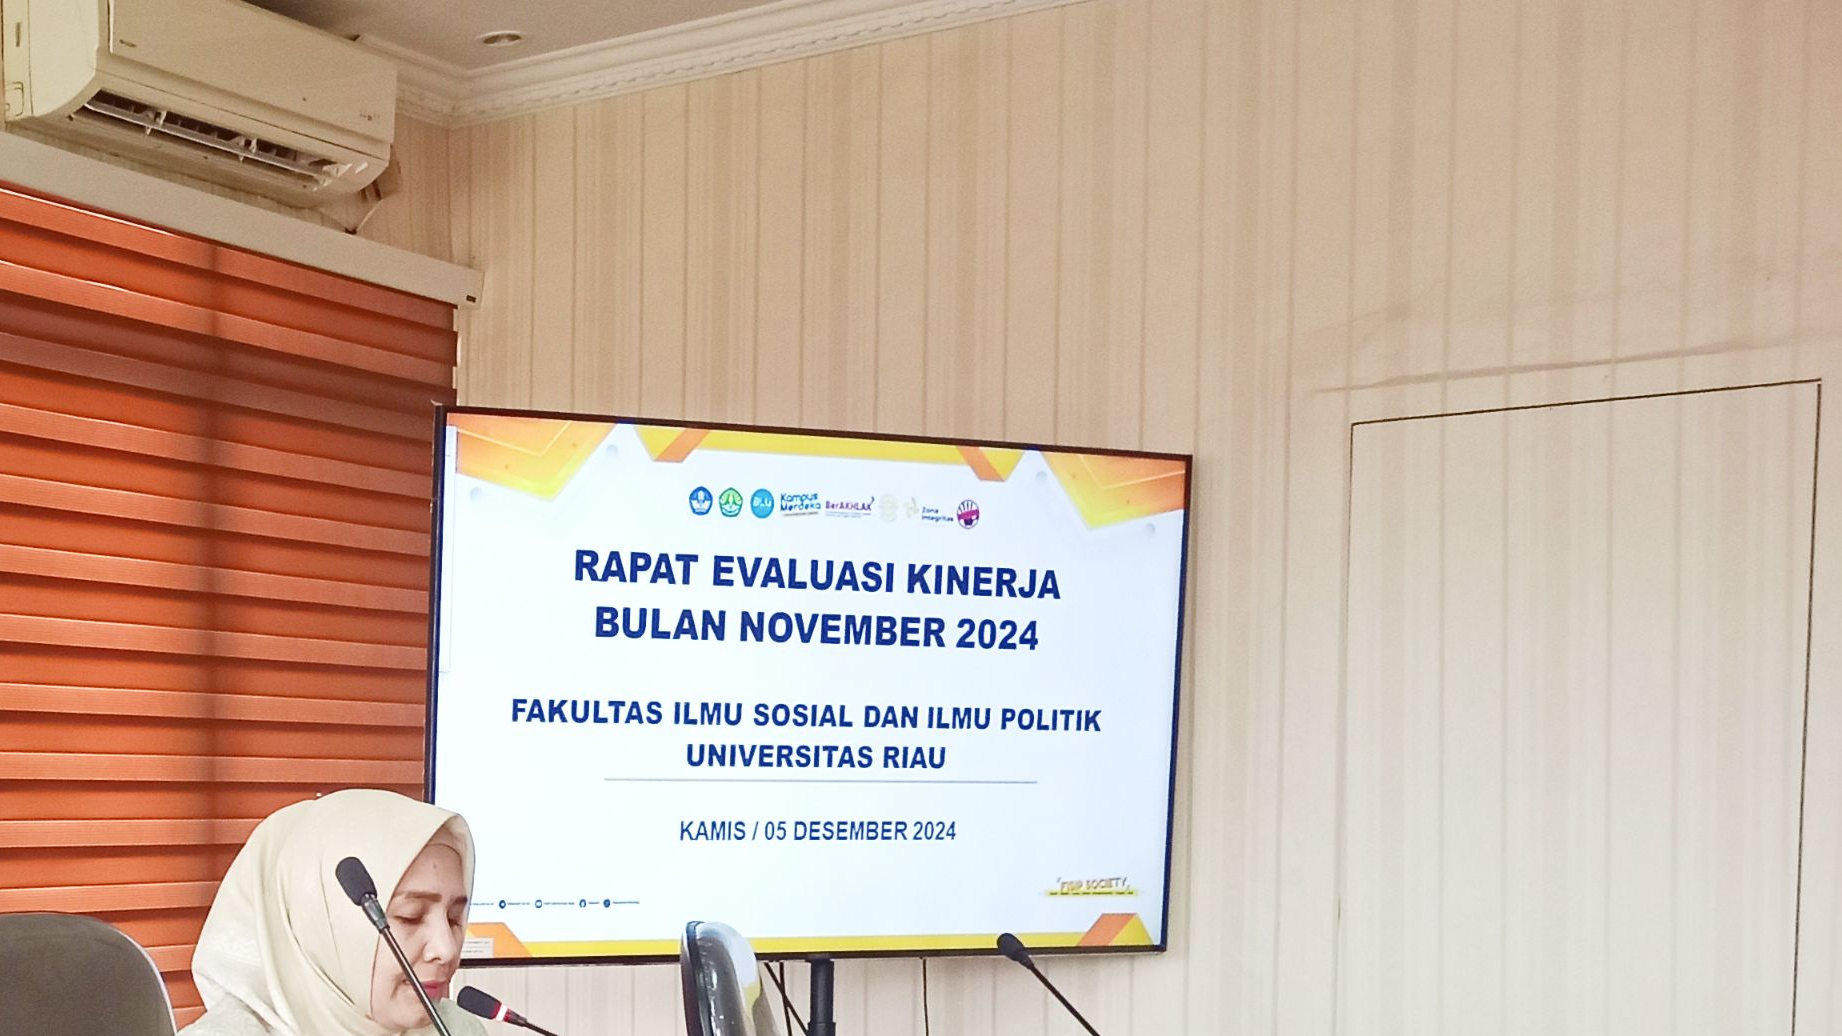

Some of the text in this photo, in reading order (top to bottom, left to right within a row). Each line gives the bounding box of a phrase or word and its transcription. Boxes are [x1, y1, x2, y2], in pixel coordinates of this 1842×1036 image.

[574, 549, 1061, 600] RAPAT EVALUASI KINERJA
[595, 606, 1039, 651] BULAN NOVEMBER 2024
[511, 698, 1102, 732] FAKULTAS ILMU SOSIAL DAN ILMU POLITIK
[686, 743, 946, 769] UNIVERSITAS RIAU
[679, 820, 957, 841] KAMIS / 05 DESEMBER 2024
